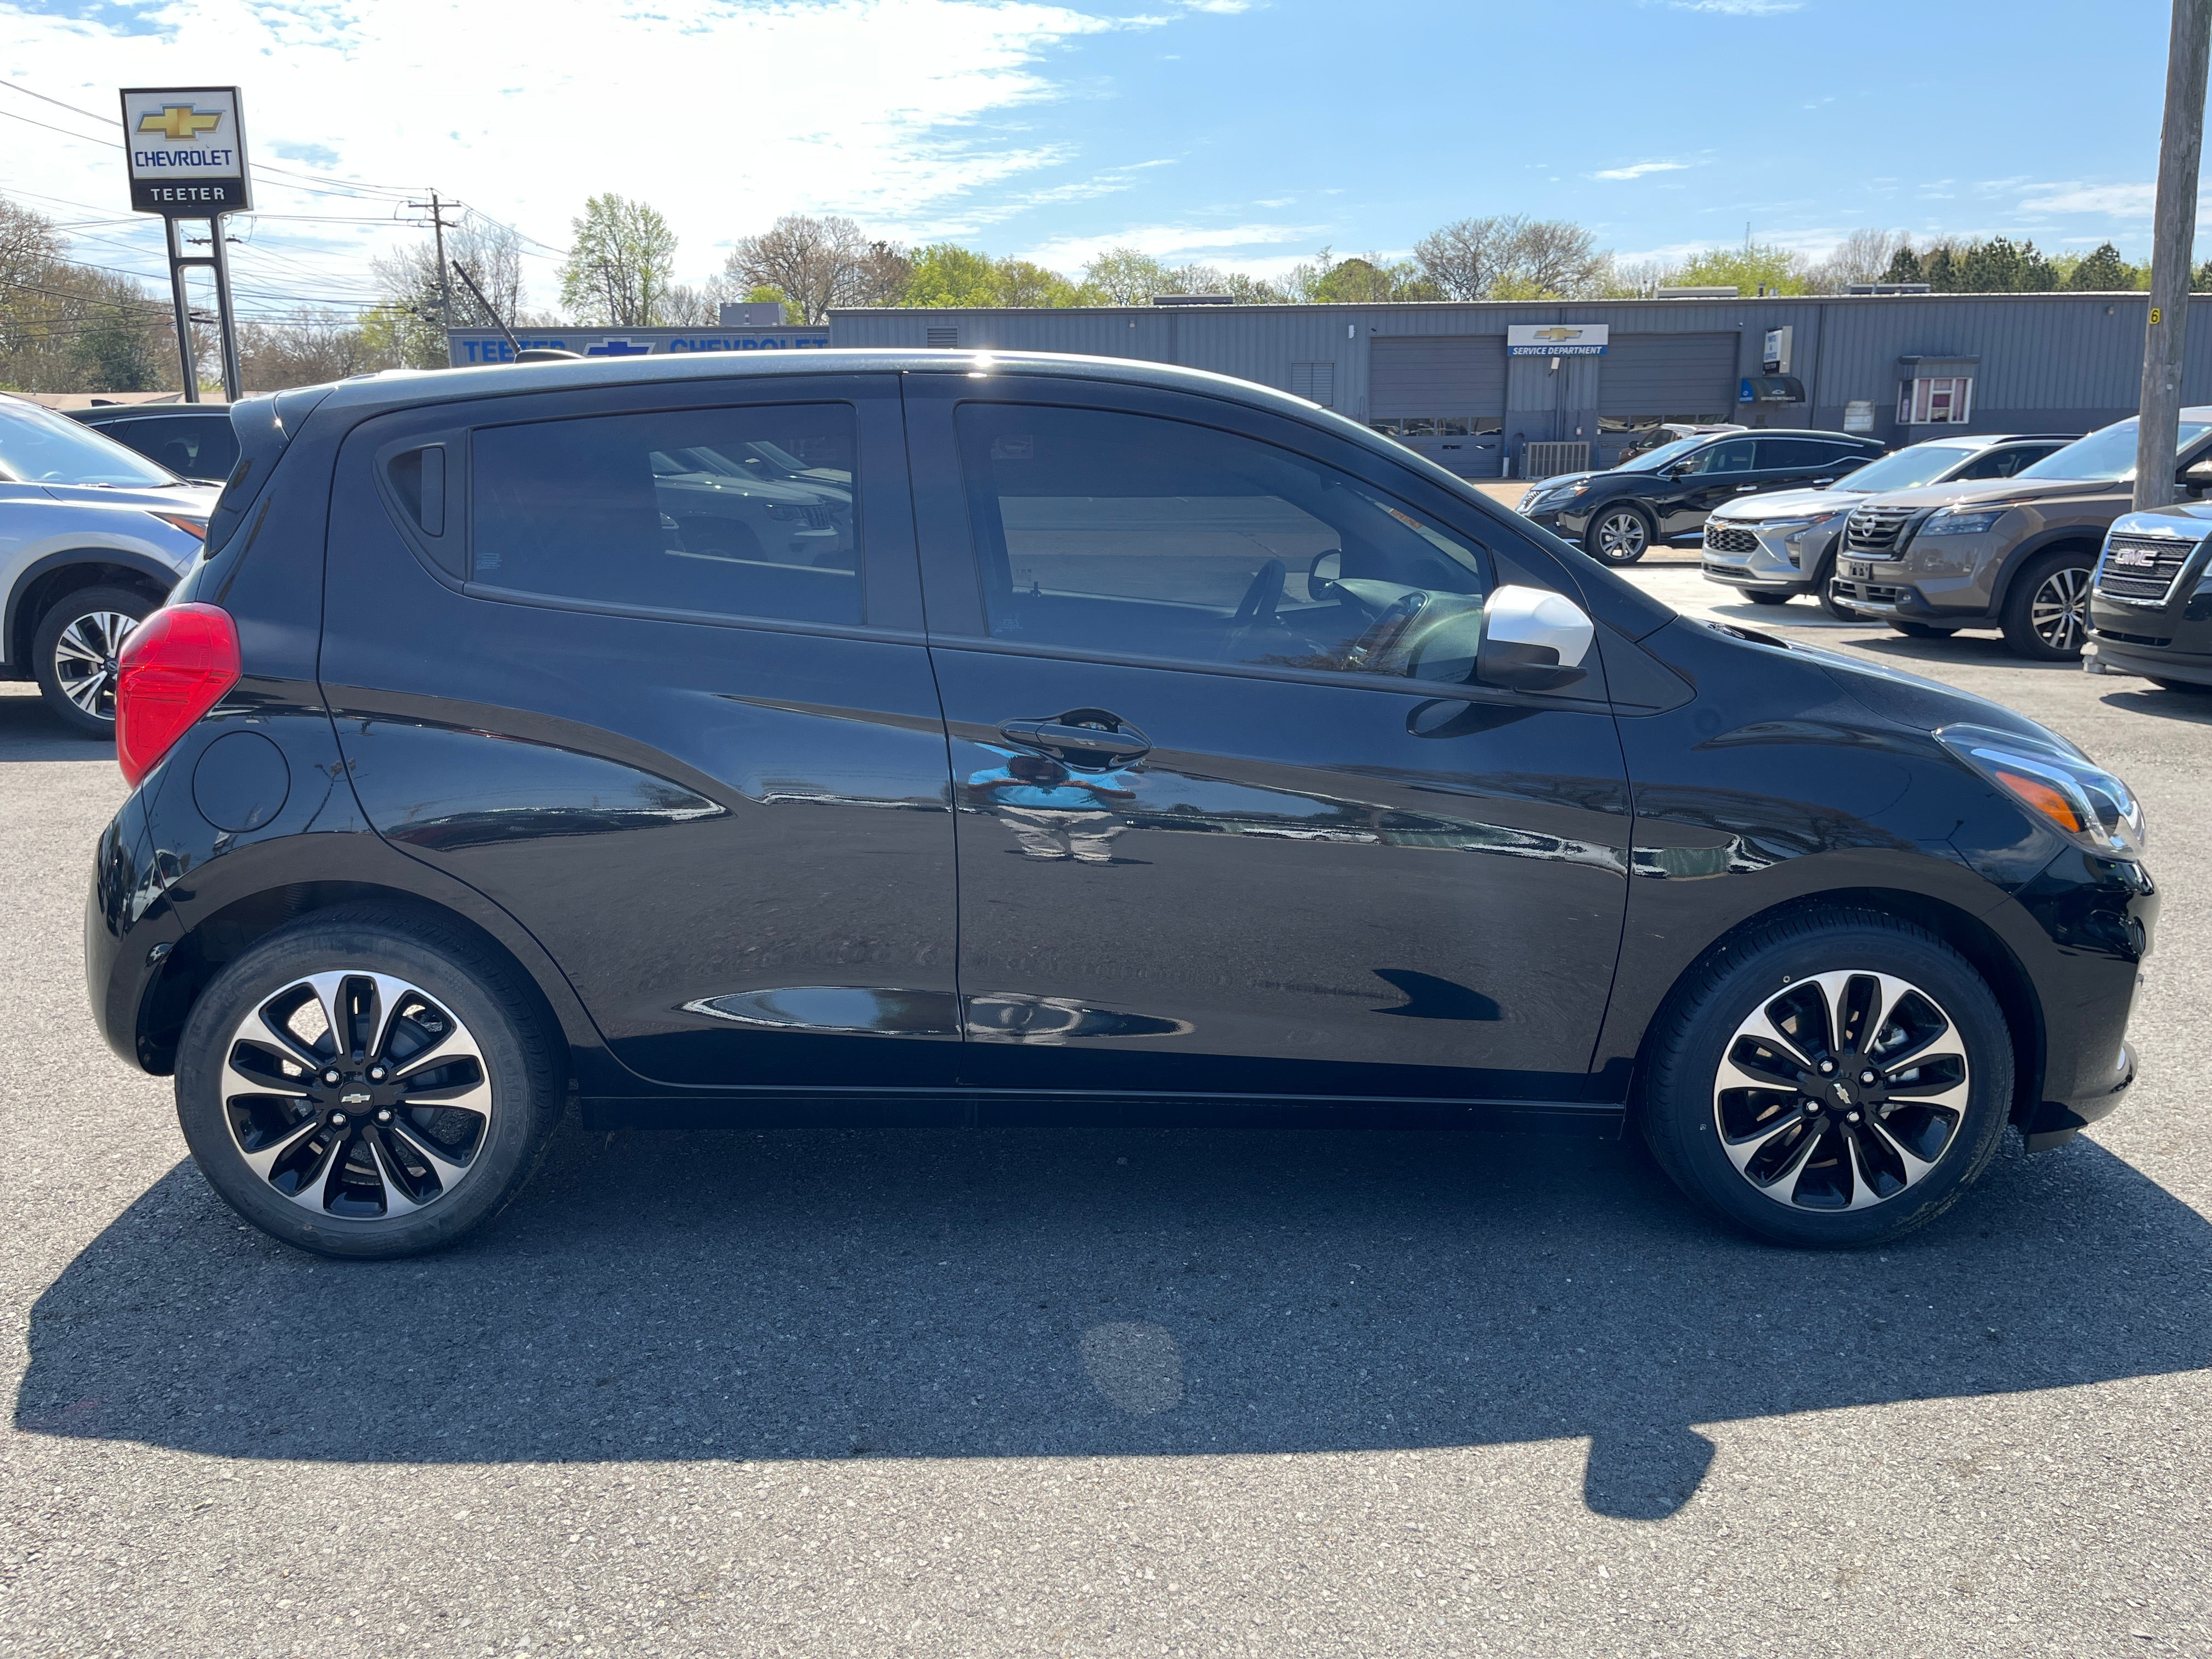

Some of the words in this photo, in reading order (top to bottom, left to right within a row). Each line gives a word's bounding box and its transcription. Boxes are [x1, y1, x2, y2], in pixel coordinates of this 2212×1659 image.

[135, 150, 232, 167] CHEVROLET
[150, 187, 225, 201] TEETER
[2151, 309, 2159, 323] 6
[1513, 347, 1547, 355] SERVICE
[1548, 346, 1602, 355] DEPARTMENT
[2114, 548, 2159, 567] GMC
